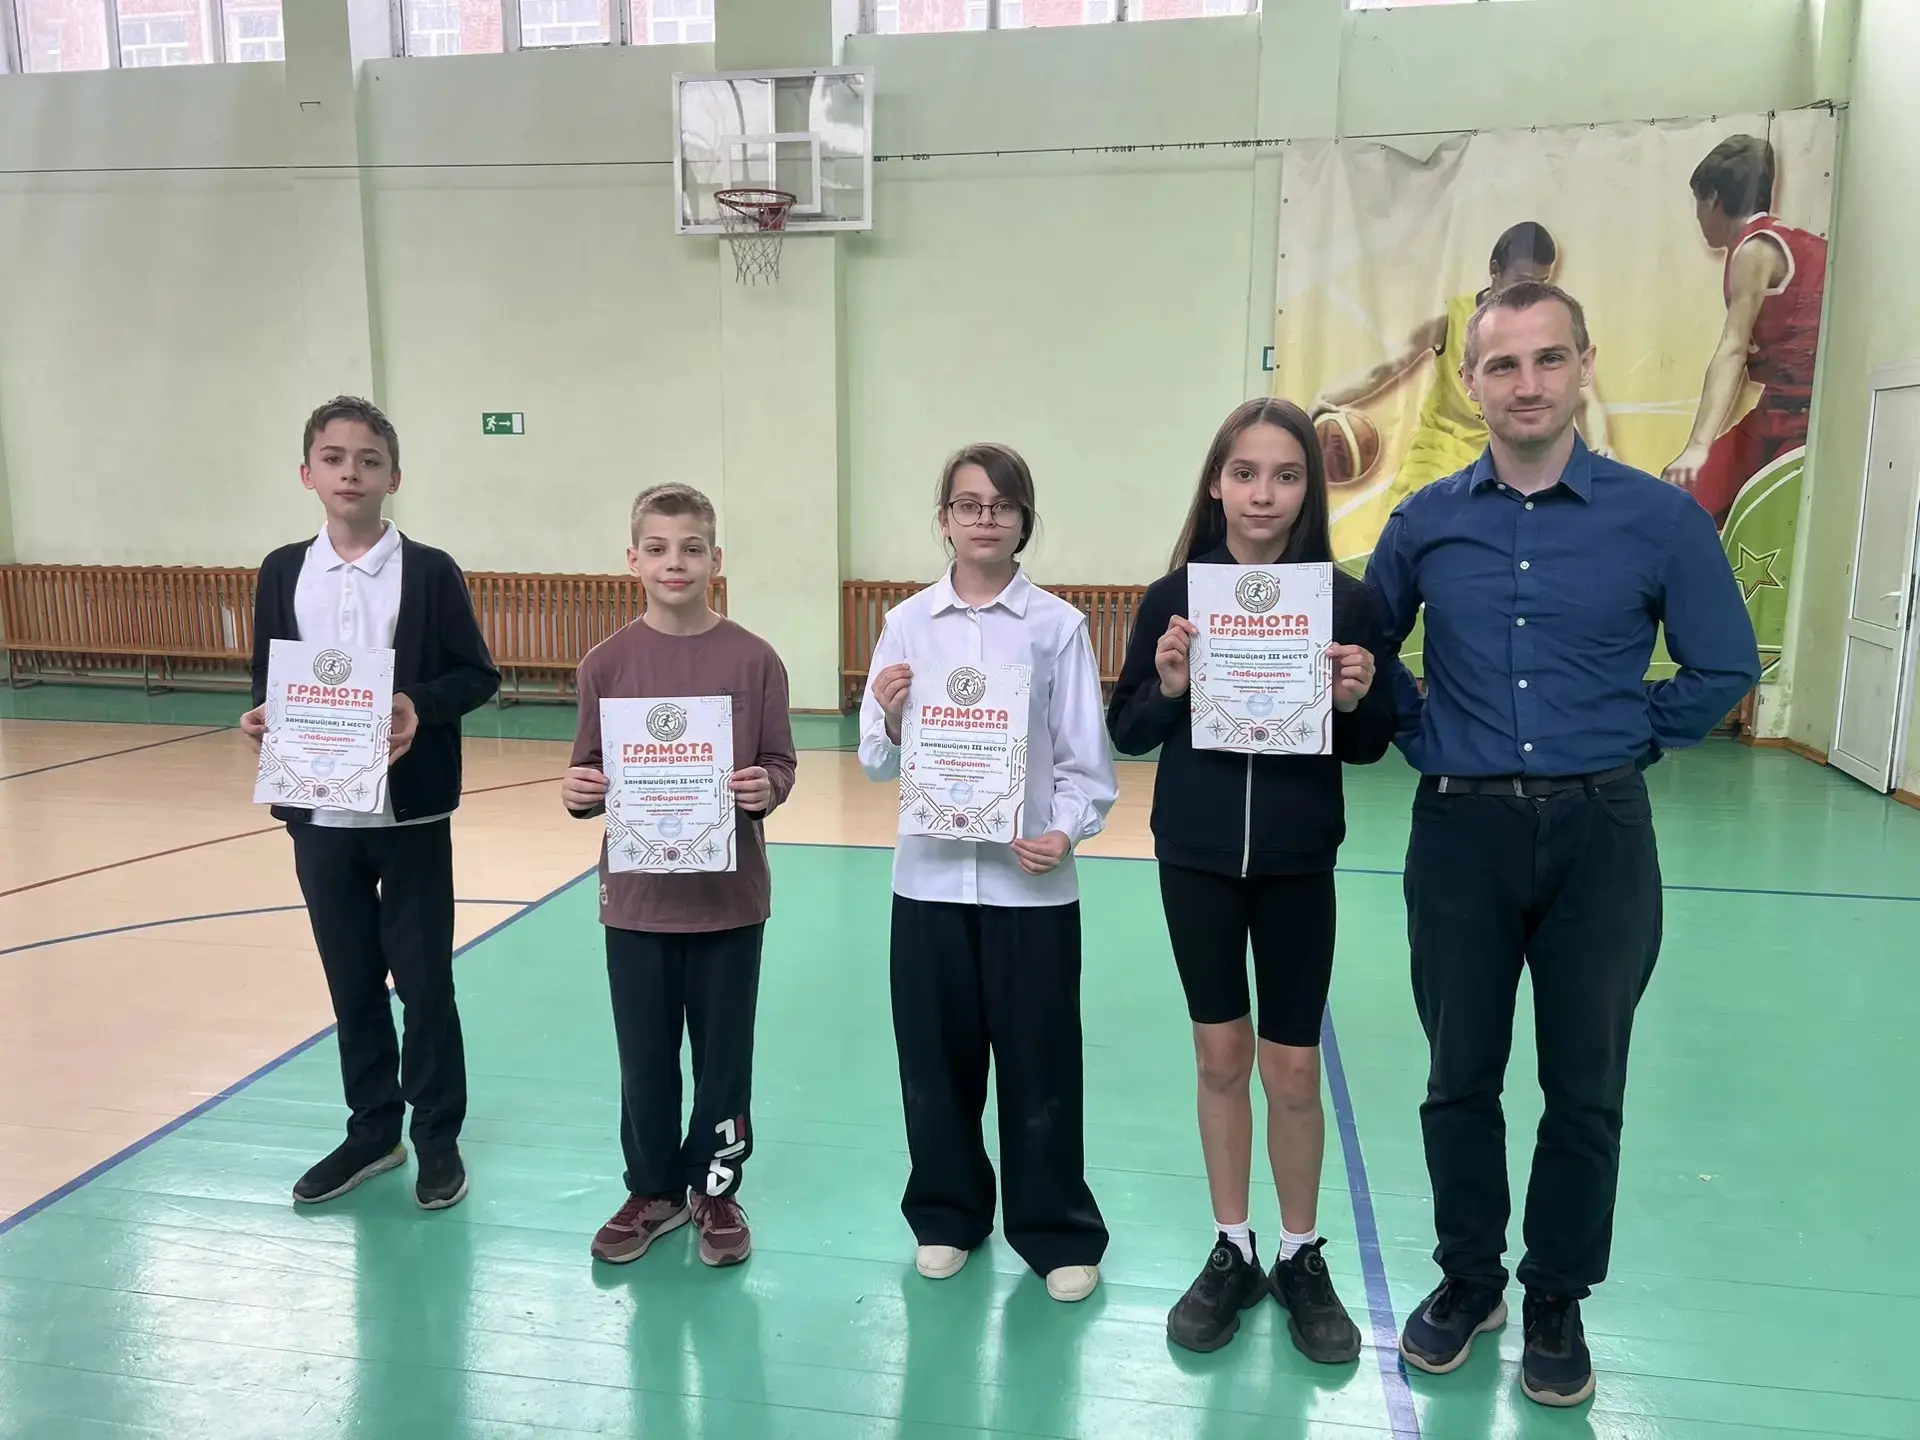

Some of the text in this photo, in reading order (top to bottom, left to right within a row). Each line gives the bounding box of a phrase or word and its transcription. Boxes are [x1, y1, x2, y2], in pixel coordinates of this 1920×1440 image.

[1209, 613, 1309, 628] ГРАМОТА
[1209, 627, 1309, 638] награждается
[1227, 670, 1291, 679] «Лабиринт»
[287, 683, 374, 701] ГРАМОТА
[286, 695, 373, 708] награждается
[922, 705, 1008, 722] ГРАМОТА
[921, 718, 1008, 730] награждается
[622, 742, 713, 756] ГРАМОТА
[983, 745, 1007, 753] МЕСТО
[623, 755, 714, 764] награждается
[934, 758, 991, 769] «Лабиринт»
